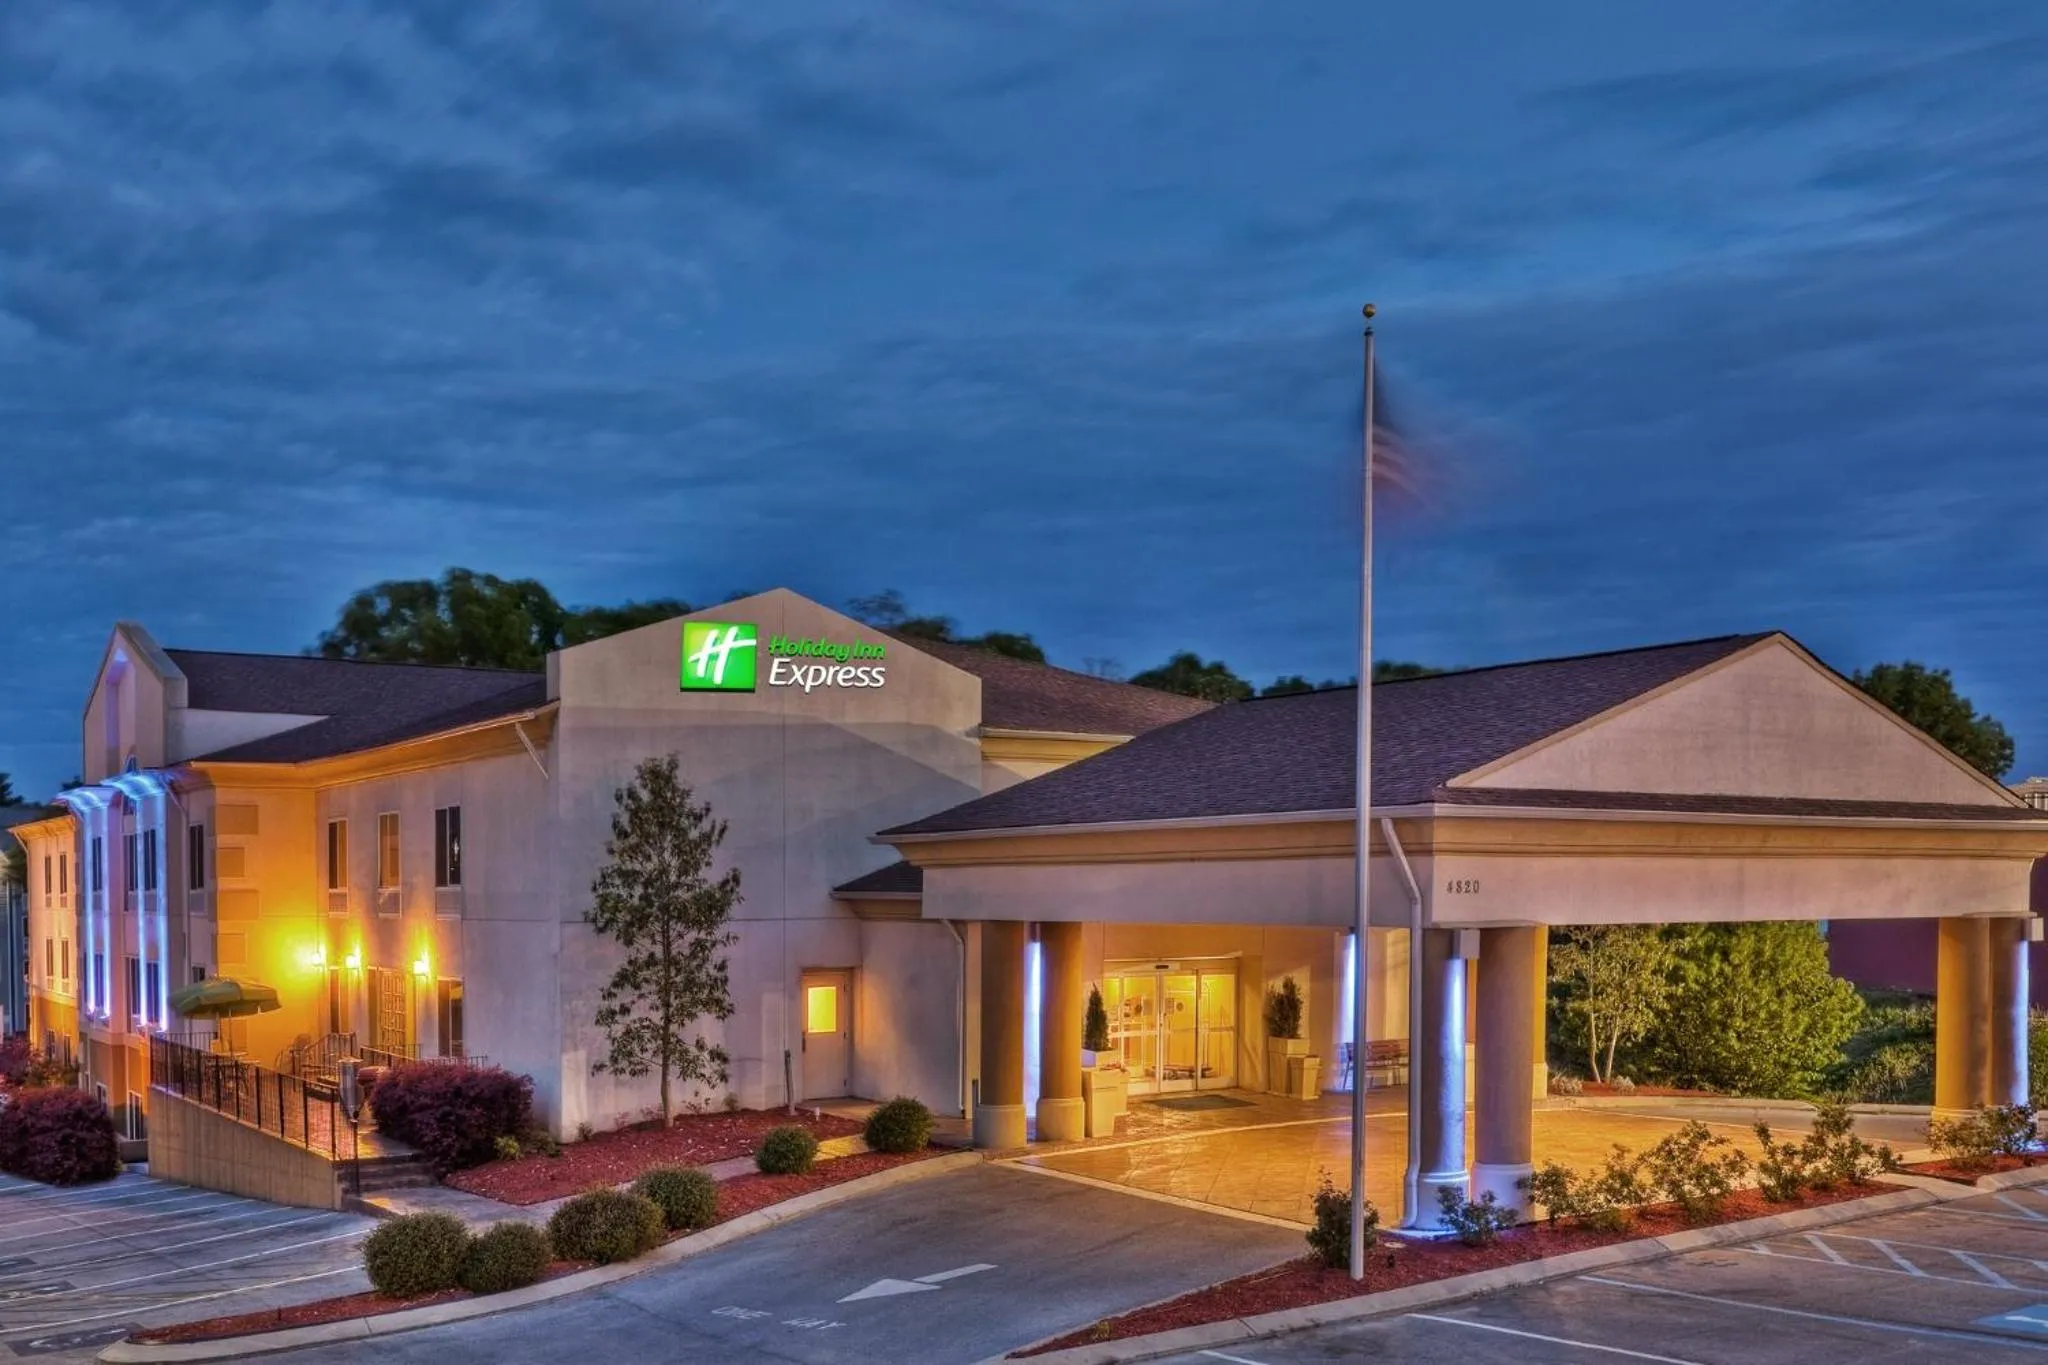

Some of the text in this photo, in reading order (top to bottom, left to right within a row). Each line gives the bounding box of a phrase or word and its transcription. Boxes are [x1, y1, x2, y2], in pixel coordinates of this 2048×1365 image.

[768, 635, 885, 662] Holiday Inn
[768, 657, 886, 694] Express
[1446, 879, 1480, 894] 4820
